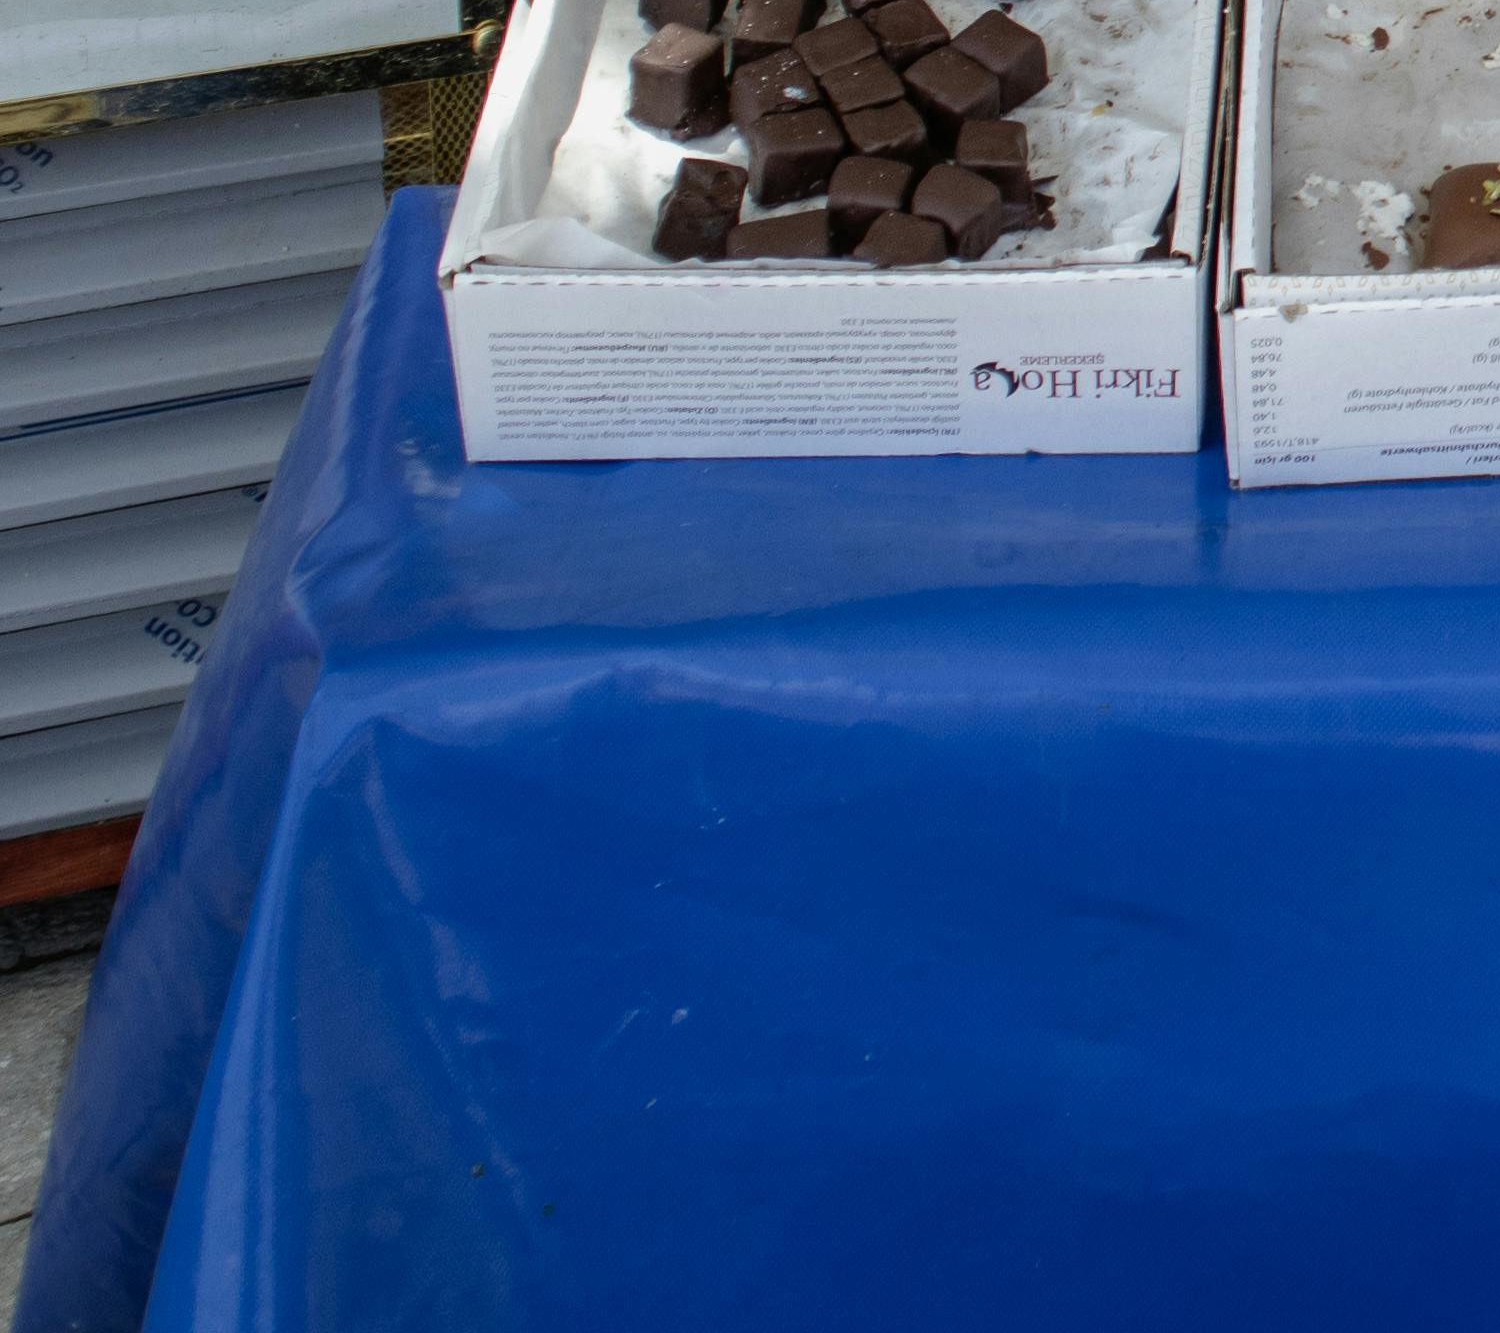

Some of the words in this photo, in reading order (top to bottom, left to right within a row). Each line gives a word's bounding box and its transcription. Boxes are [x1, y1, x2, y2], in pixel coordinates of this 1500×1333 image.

[1249, 336, 1282, 348] 0,025
[1250, 352, 1282, 364] 76,84
[1250, 368, 1276, 378] 4,48
[1092, 369, 1181, 399] Fikri
[1251, 382, 1276, 392] 0,48
[1251, 396, 1284, 407] 71,84
[1252, 410, 1277, 421] 1,40
[1252, 424, 1277, 434] 12,6
[1280, 453, 1291, 462] gr
[1294, 454, 1316, 463] 100
